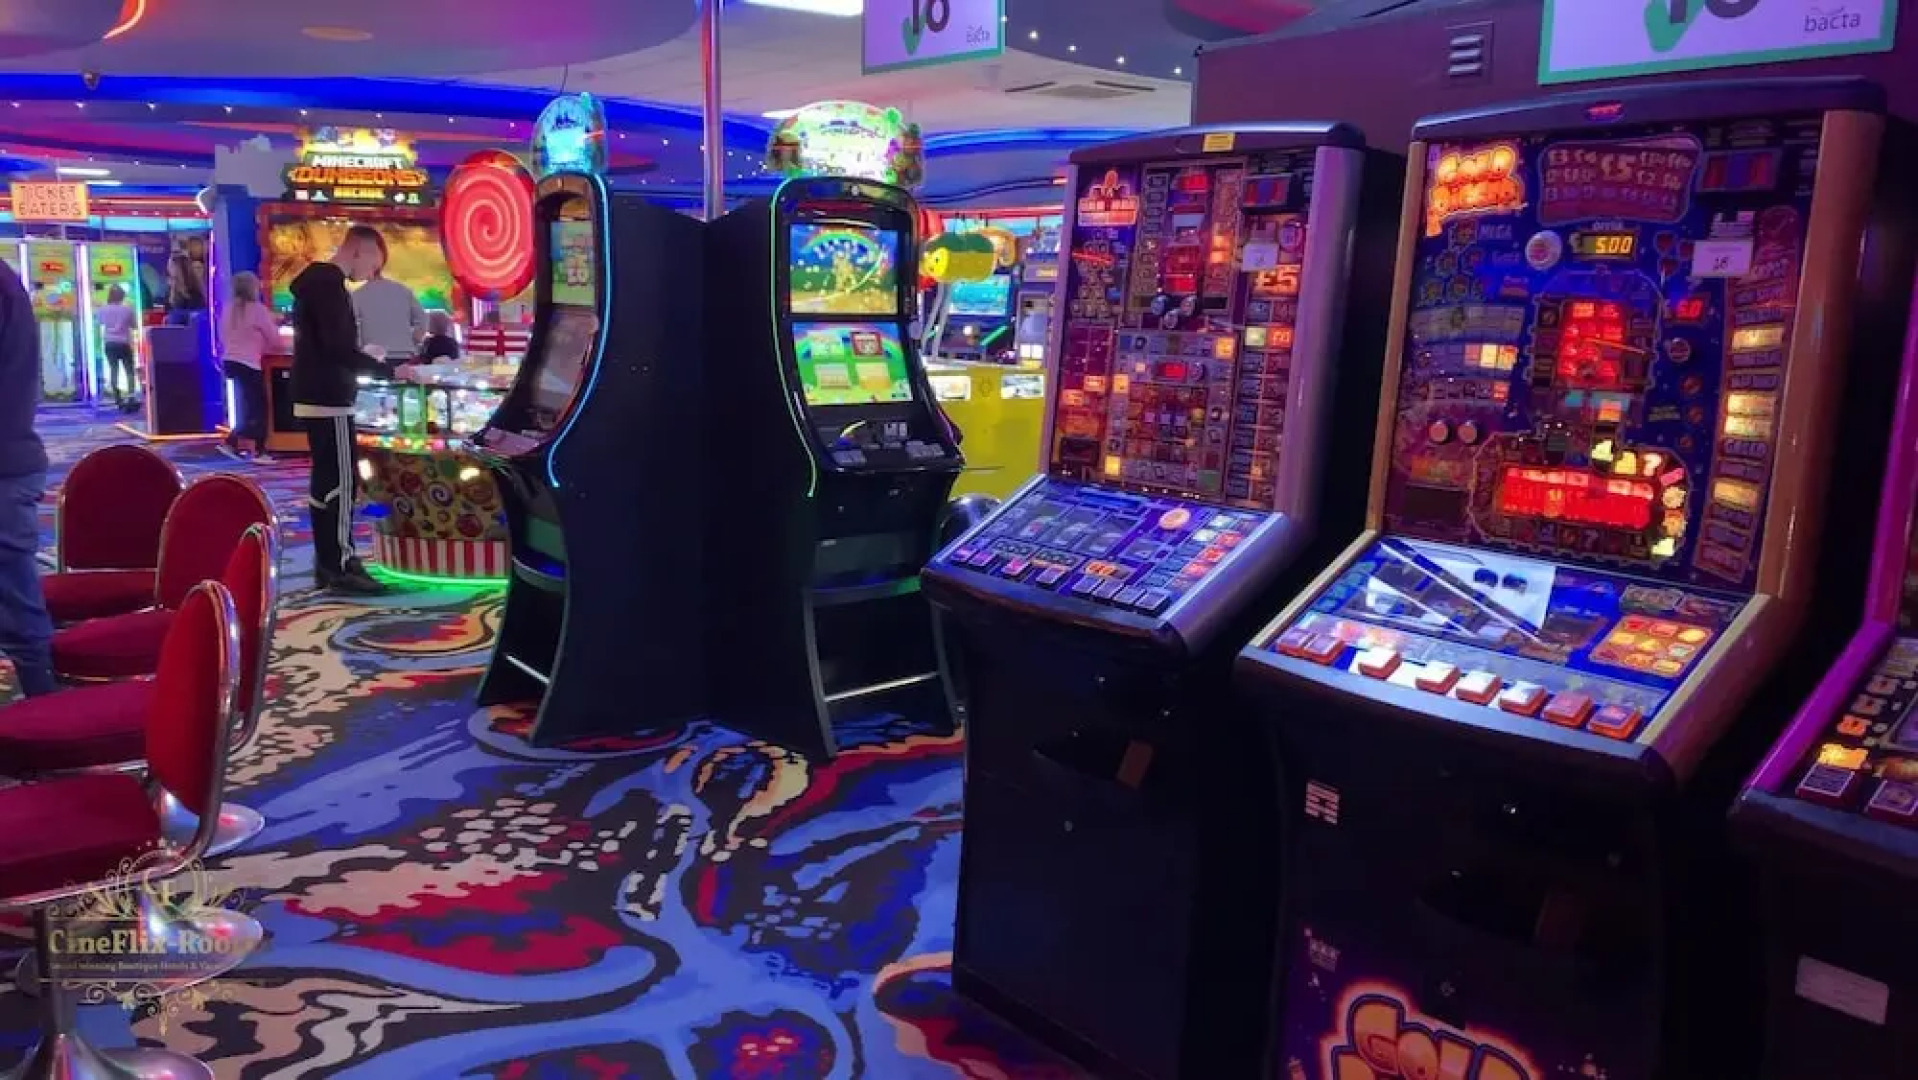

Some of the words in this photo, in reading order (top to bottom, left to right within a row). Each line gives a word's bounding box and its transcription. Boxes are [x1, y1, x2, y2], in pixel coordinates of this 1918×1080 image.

[1804, 13, 1861, 32] bacta
[312, 154, 404, 169] MINECRAFT
[294, 166, 421, 187] DUNGEONS
